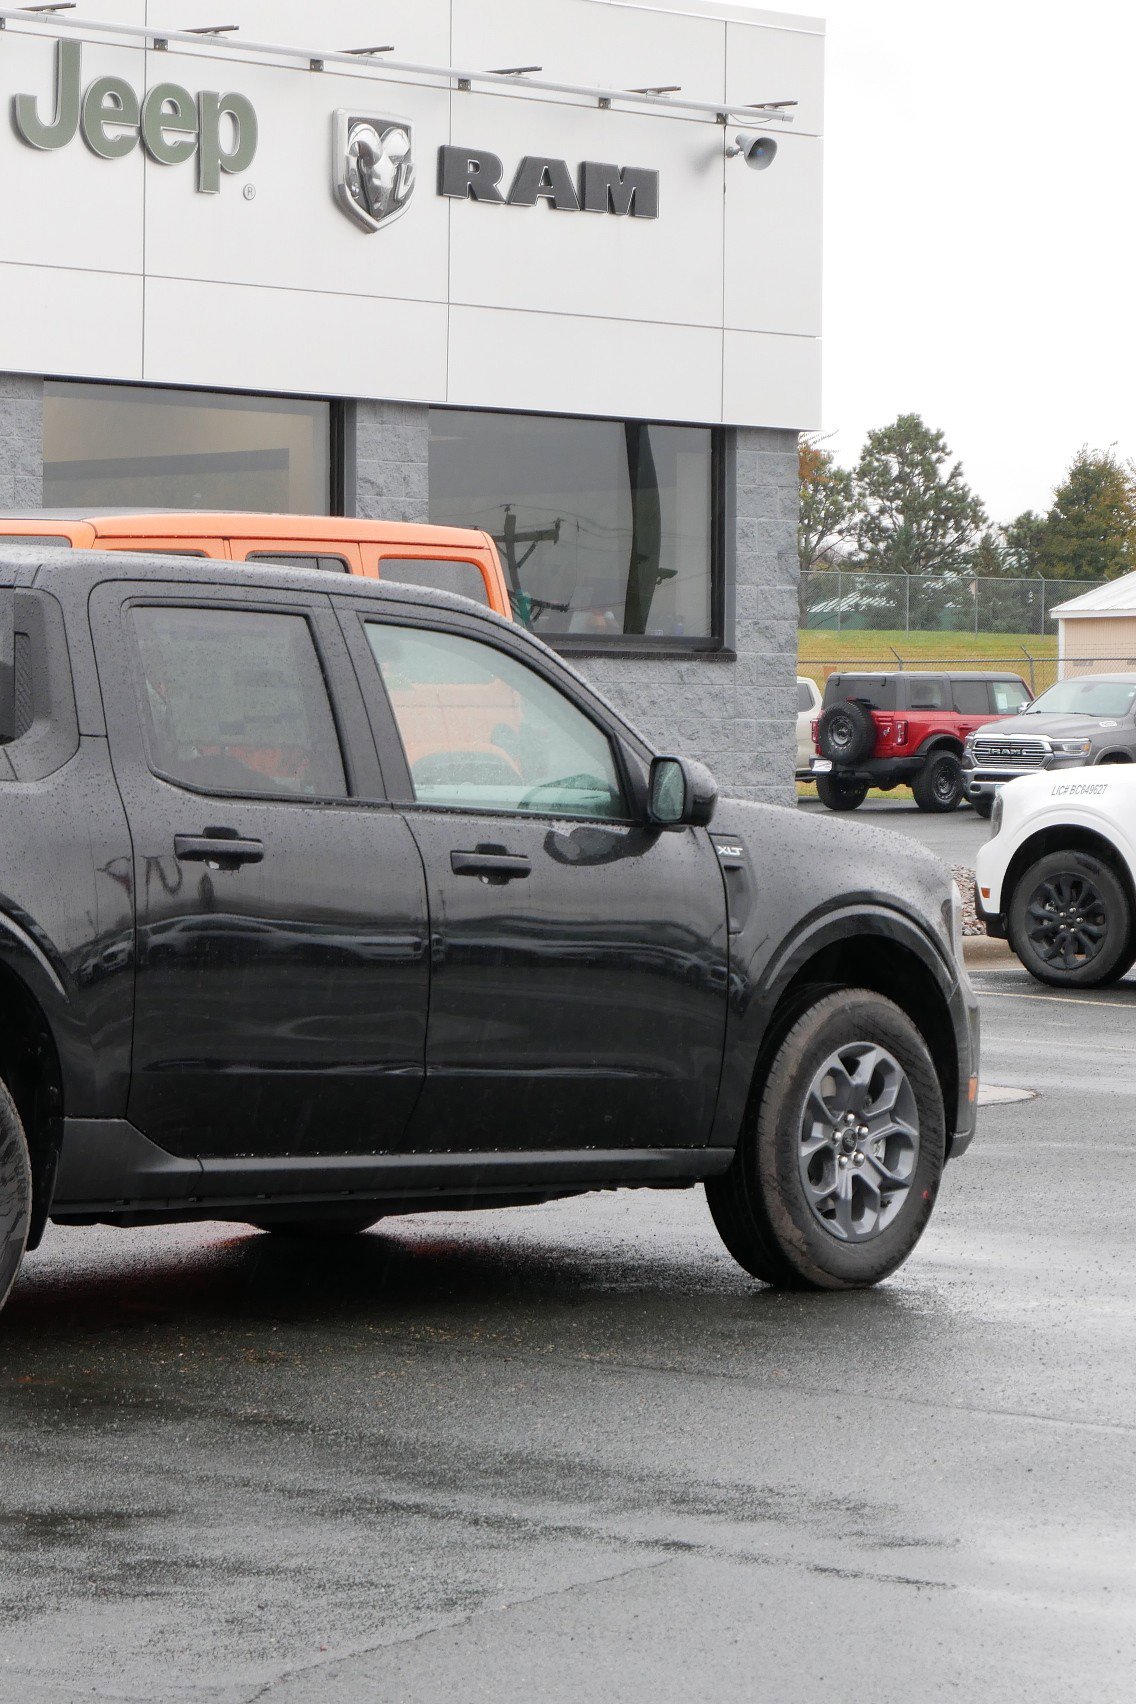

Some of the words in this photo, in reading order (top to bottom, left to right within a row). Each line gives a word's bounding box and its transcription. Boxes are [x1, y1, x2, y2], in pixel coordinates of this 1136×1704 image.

[13, 38, 259, 194] Jeep
[440, 145, 660, 219] RAM
[1051, 785, 1070, 796] LIC#
[717, 845, 744, 856] XLT
